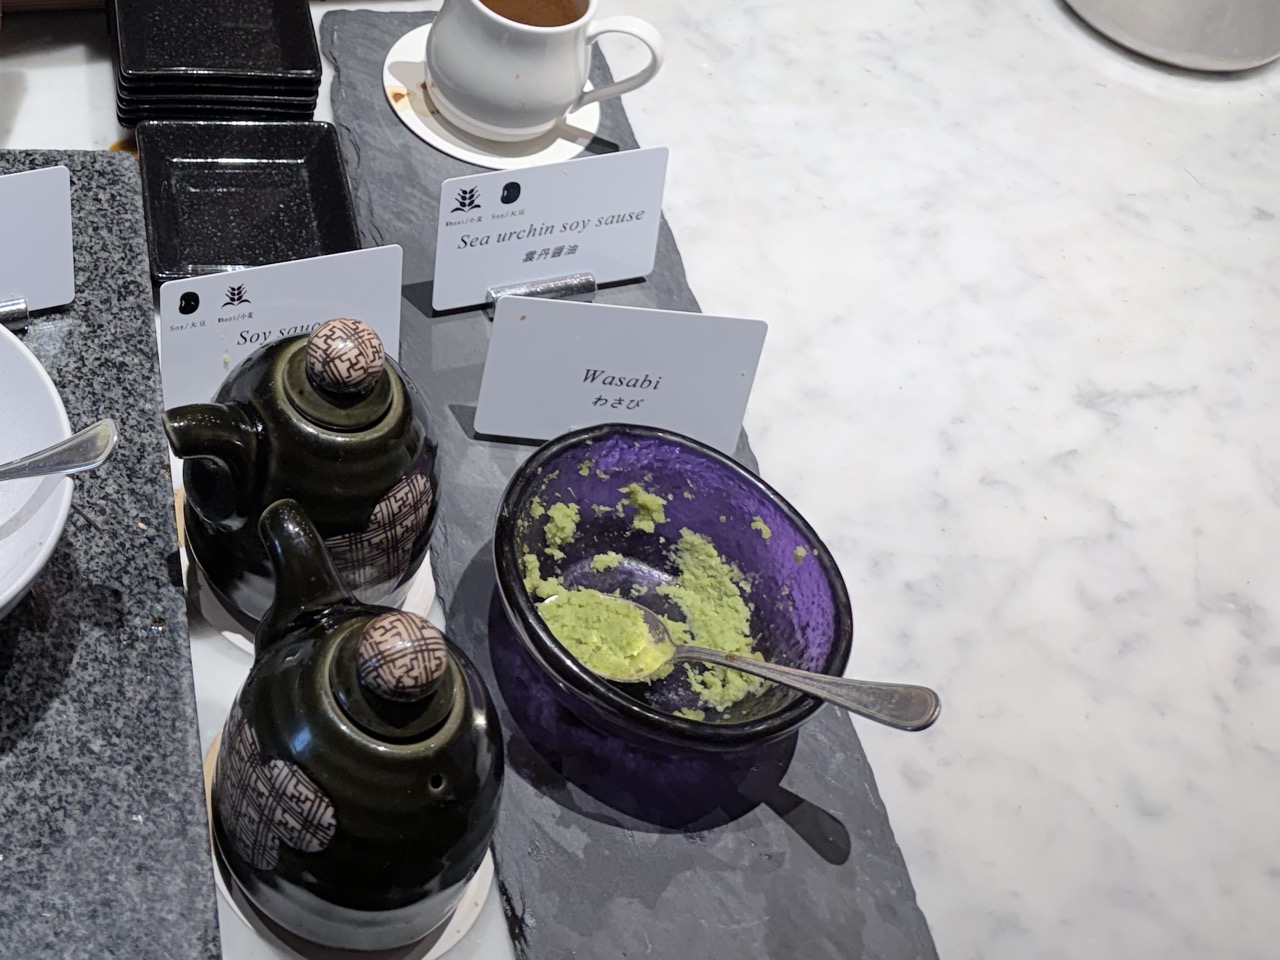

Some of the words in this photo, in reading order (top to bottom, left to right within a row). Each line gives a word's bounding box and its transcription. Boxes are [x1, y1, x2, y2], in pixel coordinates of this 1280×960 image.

[457, 234, 491, 250] Sea
[496, 222, 555, 243] urchin
[559, 218, 591, 235] soy
[595, 209, 646, 228] sause
[237, 329, 272, 346] Soy
[582, 368, 662, 390] Wasabi
[592, 394, 644, 411] わさび
